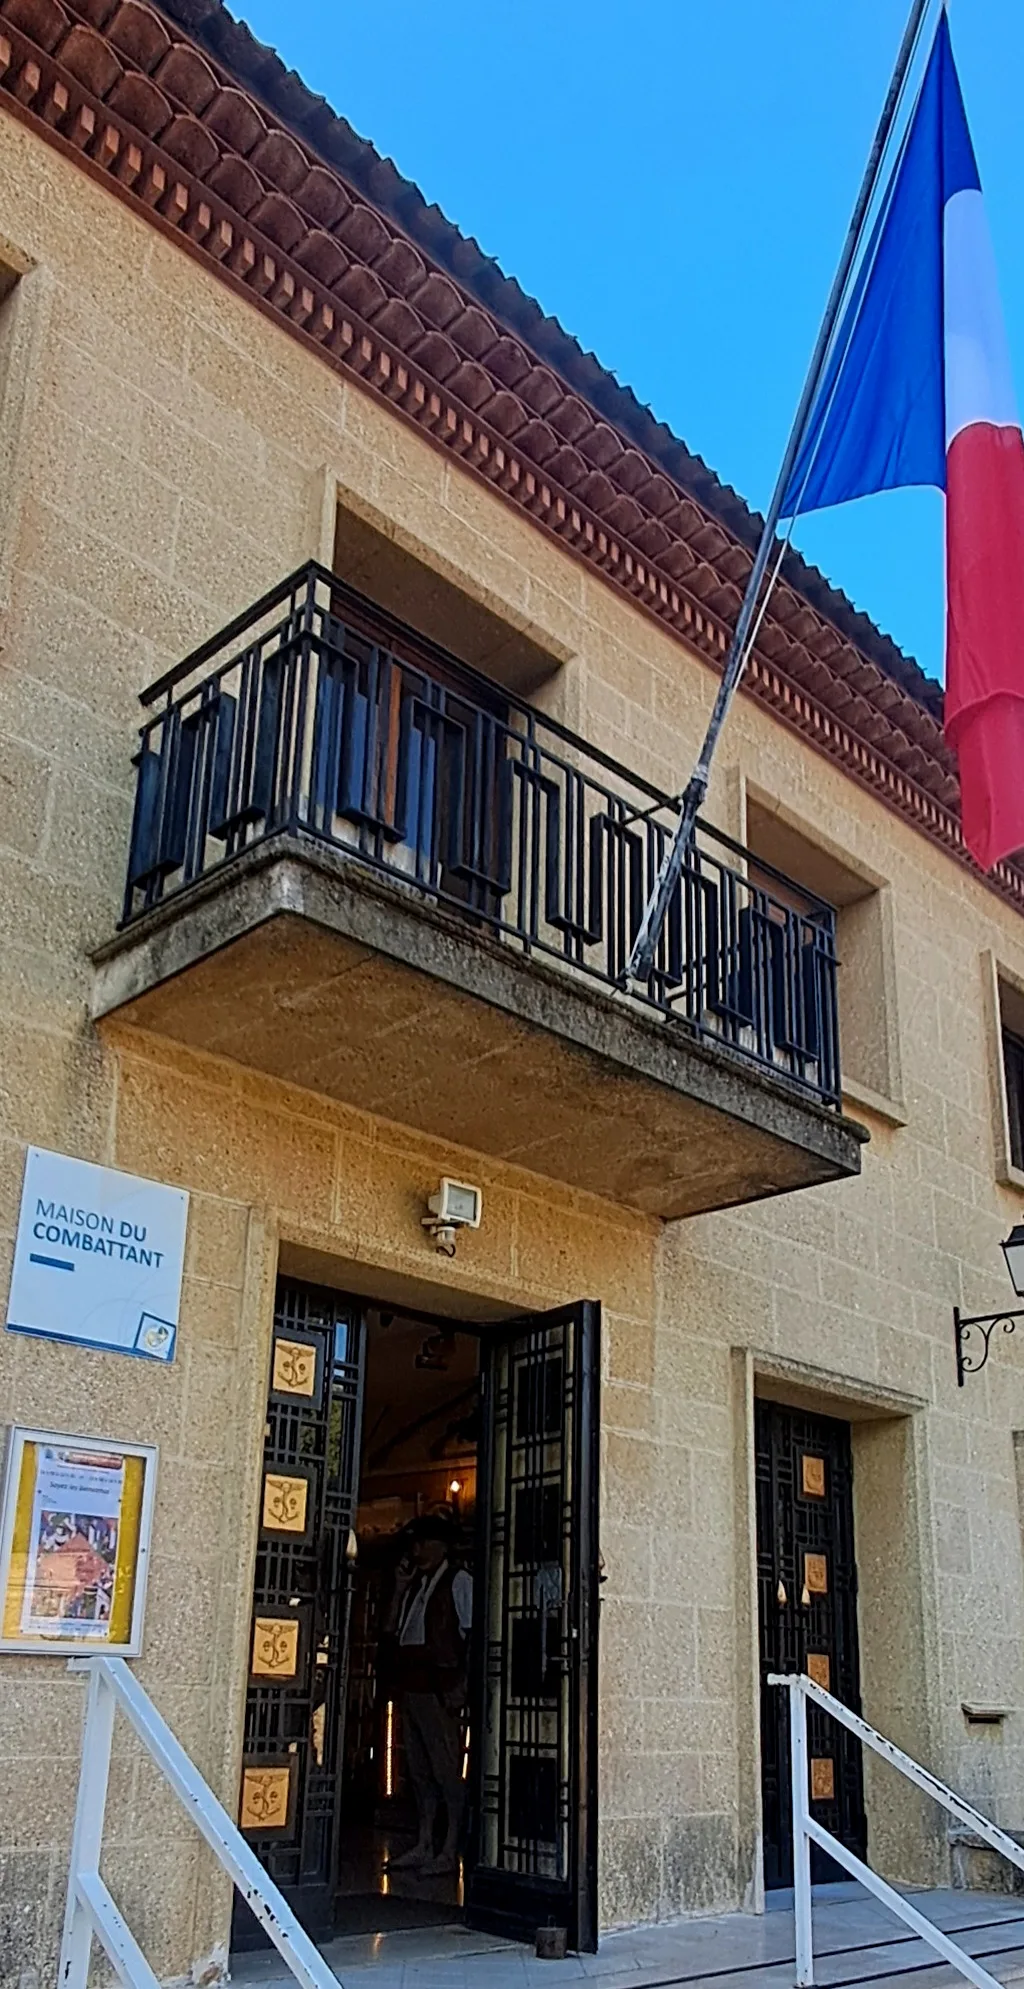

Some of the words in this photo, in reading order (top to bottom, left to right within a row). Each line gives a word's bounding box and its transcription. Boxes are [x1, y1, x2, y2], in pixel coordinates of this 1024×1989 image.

[36, 1199, 114, 1234] MAISON
[120, 1221, 147, 1242] DU
[33, 1222, 165, 1268] COMBATTANT
